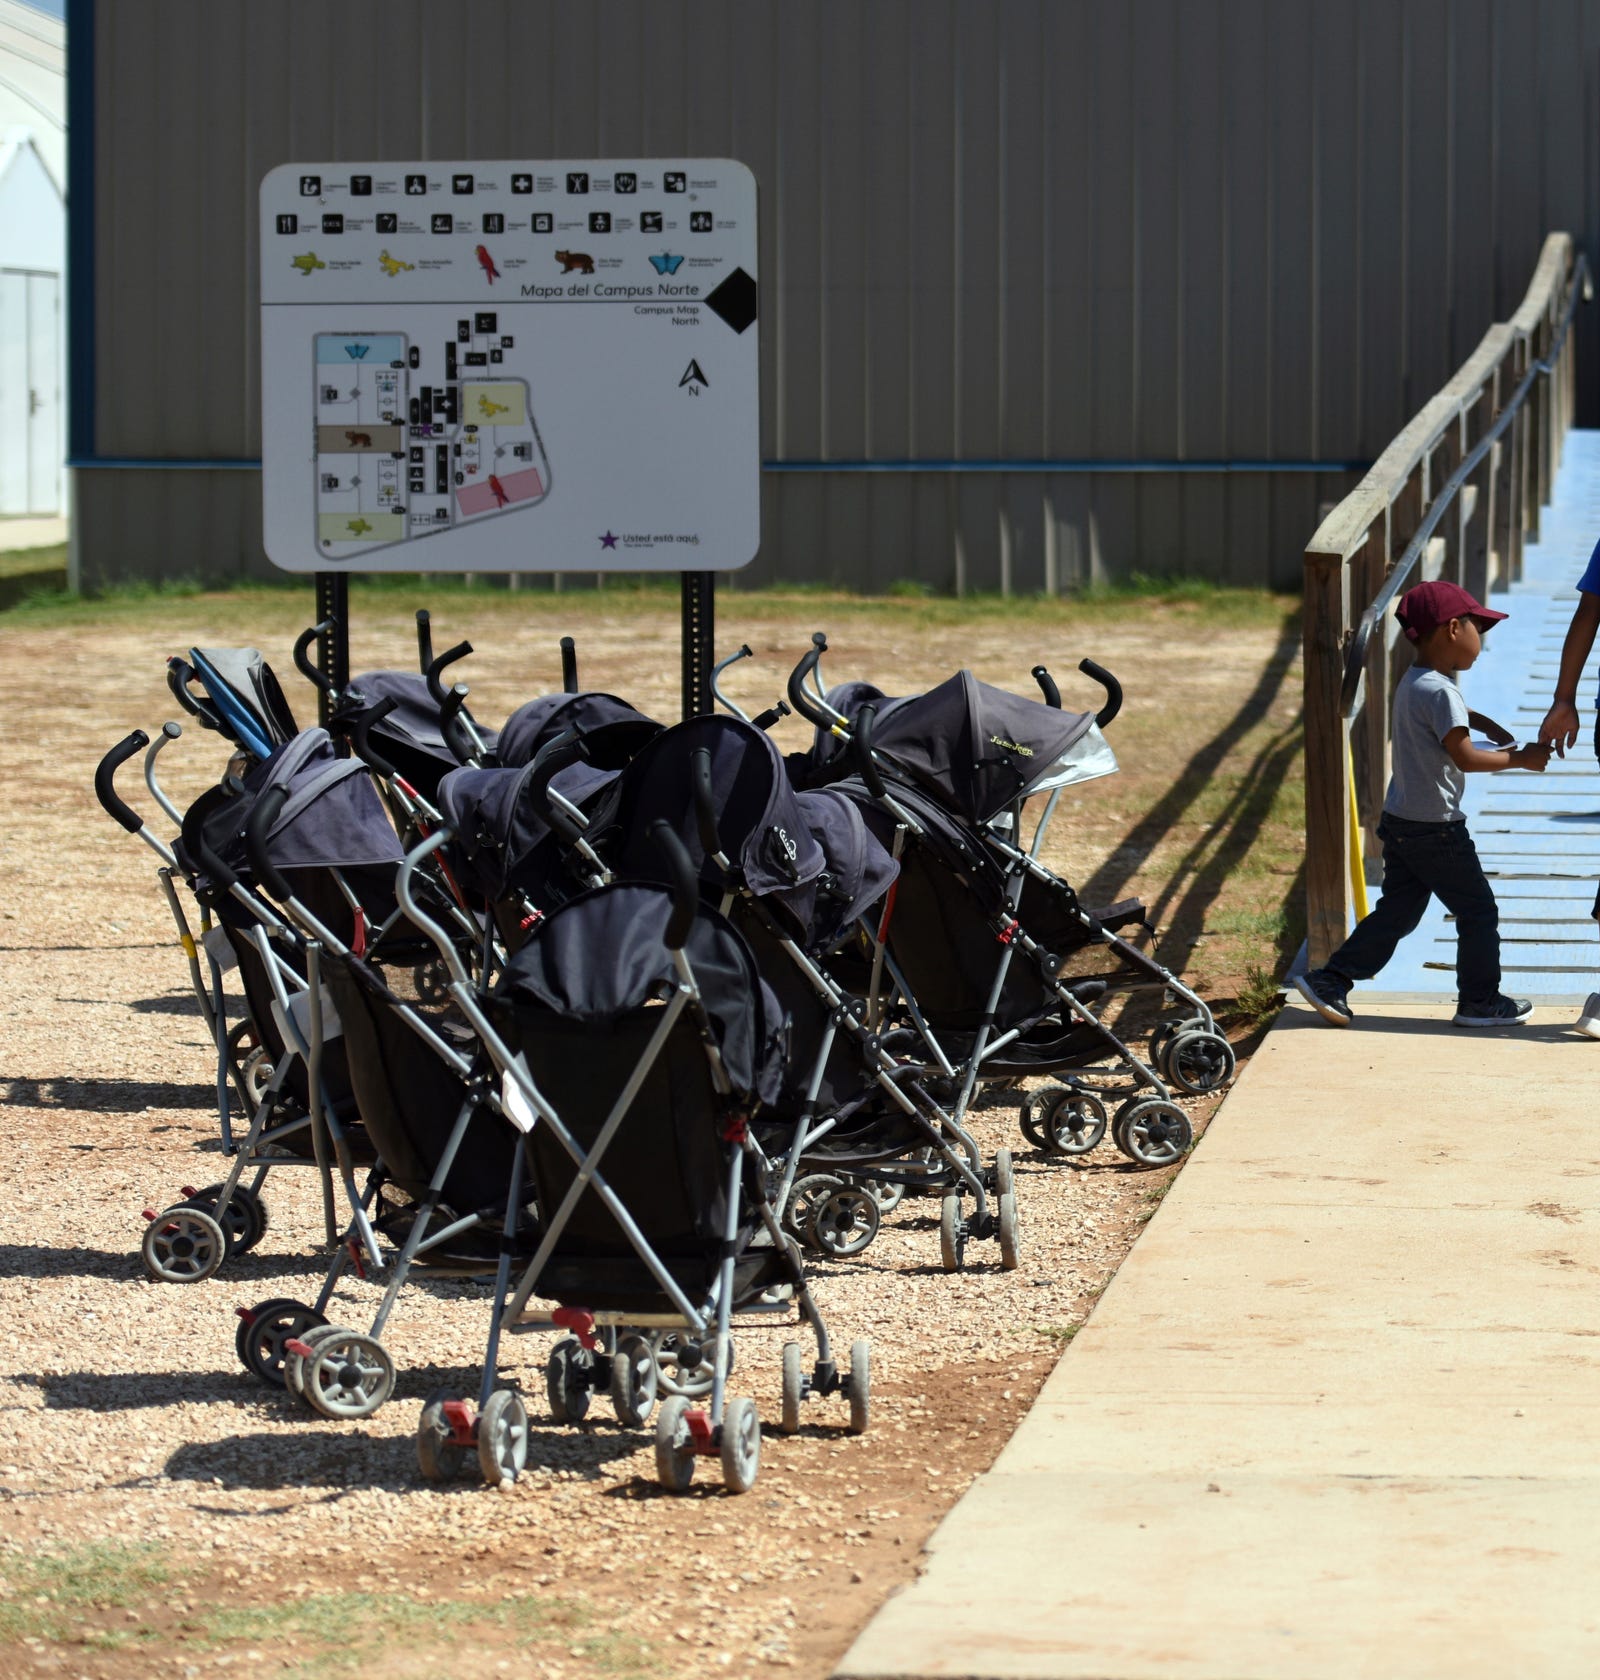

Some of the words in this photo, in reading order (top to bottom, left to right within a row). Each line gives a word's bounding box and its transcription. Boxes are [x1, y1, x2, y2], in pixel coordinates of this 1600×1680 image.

[520, 284, 563, 299] Mapa
[567, 284, 589, 297] del
[593, 283, 653, 299] Campus
[658, 283, 699, 296] Norte
[633, 305, 674, 316] Campus
[677, 305, 700, 316] Map
[671, 316, 700, 326] North
[688, 385, 699, 397] N
[623, 534, 651, 543] Usted
[1012, 743, 1033, 757] Jeep
